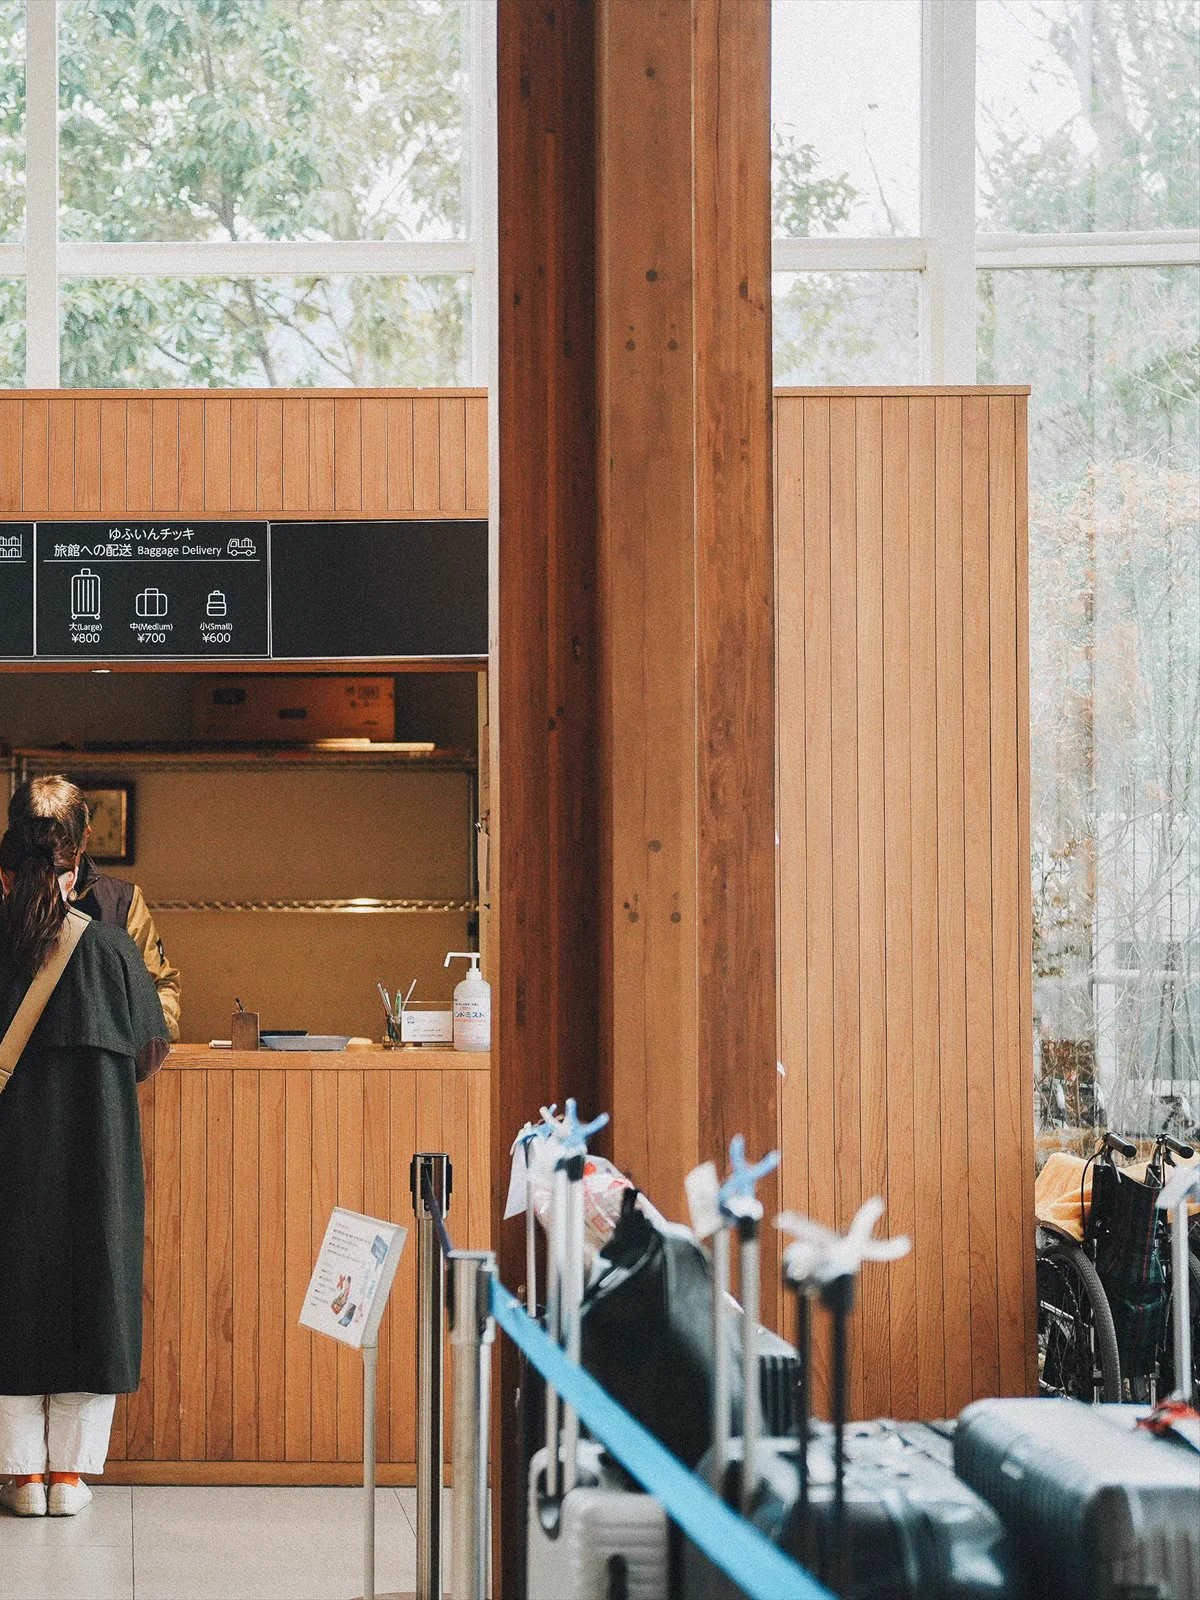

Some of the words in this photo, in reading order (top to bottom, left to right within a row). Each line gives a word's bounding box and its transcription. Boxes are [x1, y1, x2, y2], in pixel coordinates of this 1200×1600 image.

[108, 528, 194, 541] ゆふいんチッキ
[54, 544, 132, 557] 旅館への配送
[138, 546, 179, 558] Baggage
[182, 545, 222, 557] Delivery
[68, 622, 102, 632] 大(Large)
[130, 622, 173, 631] 中(Medium)
[200, 622, 233, 631] 小(Small)
[71, 632, 100, 643] ¥800
[137, 632, 166, 643] ¥700
[202, 632, 231, 643] ¥600
